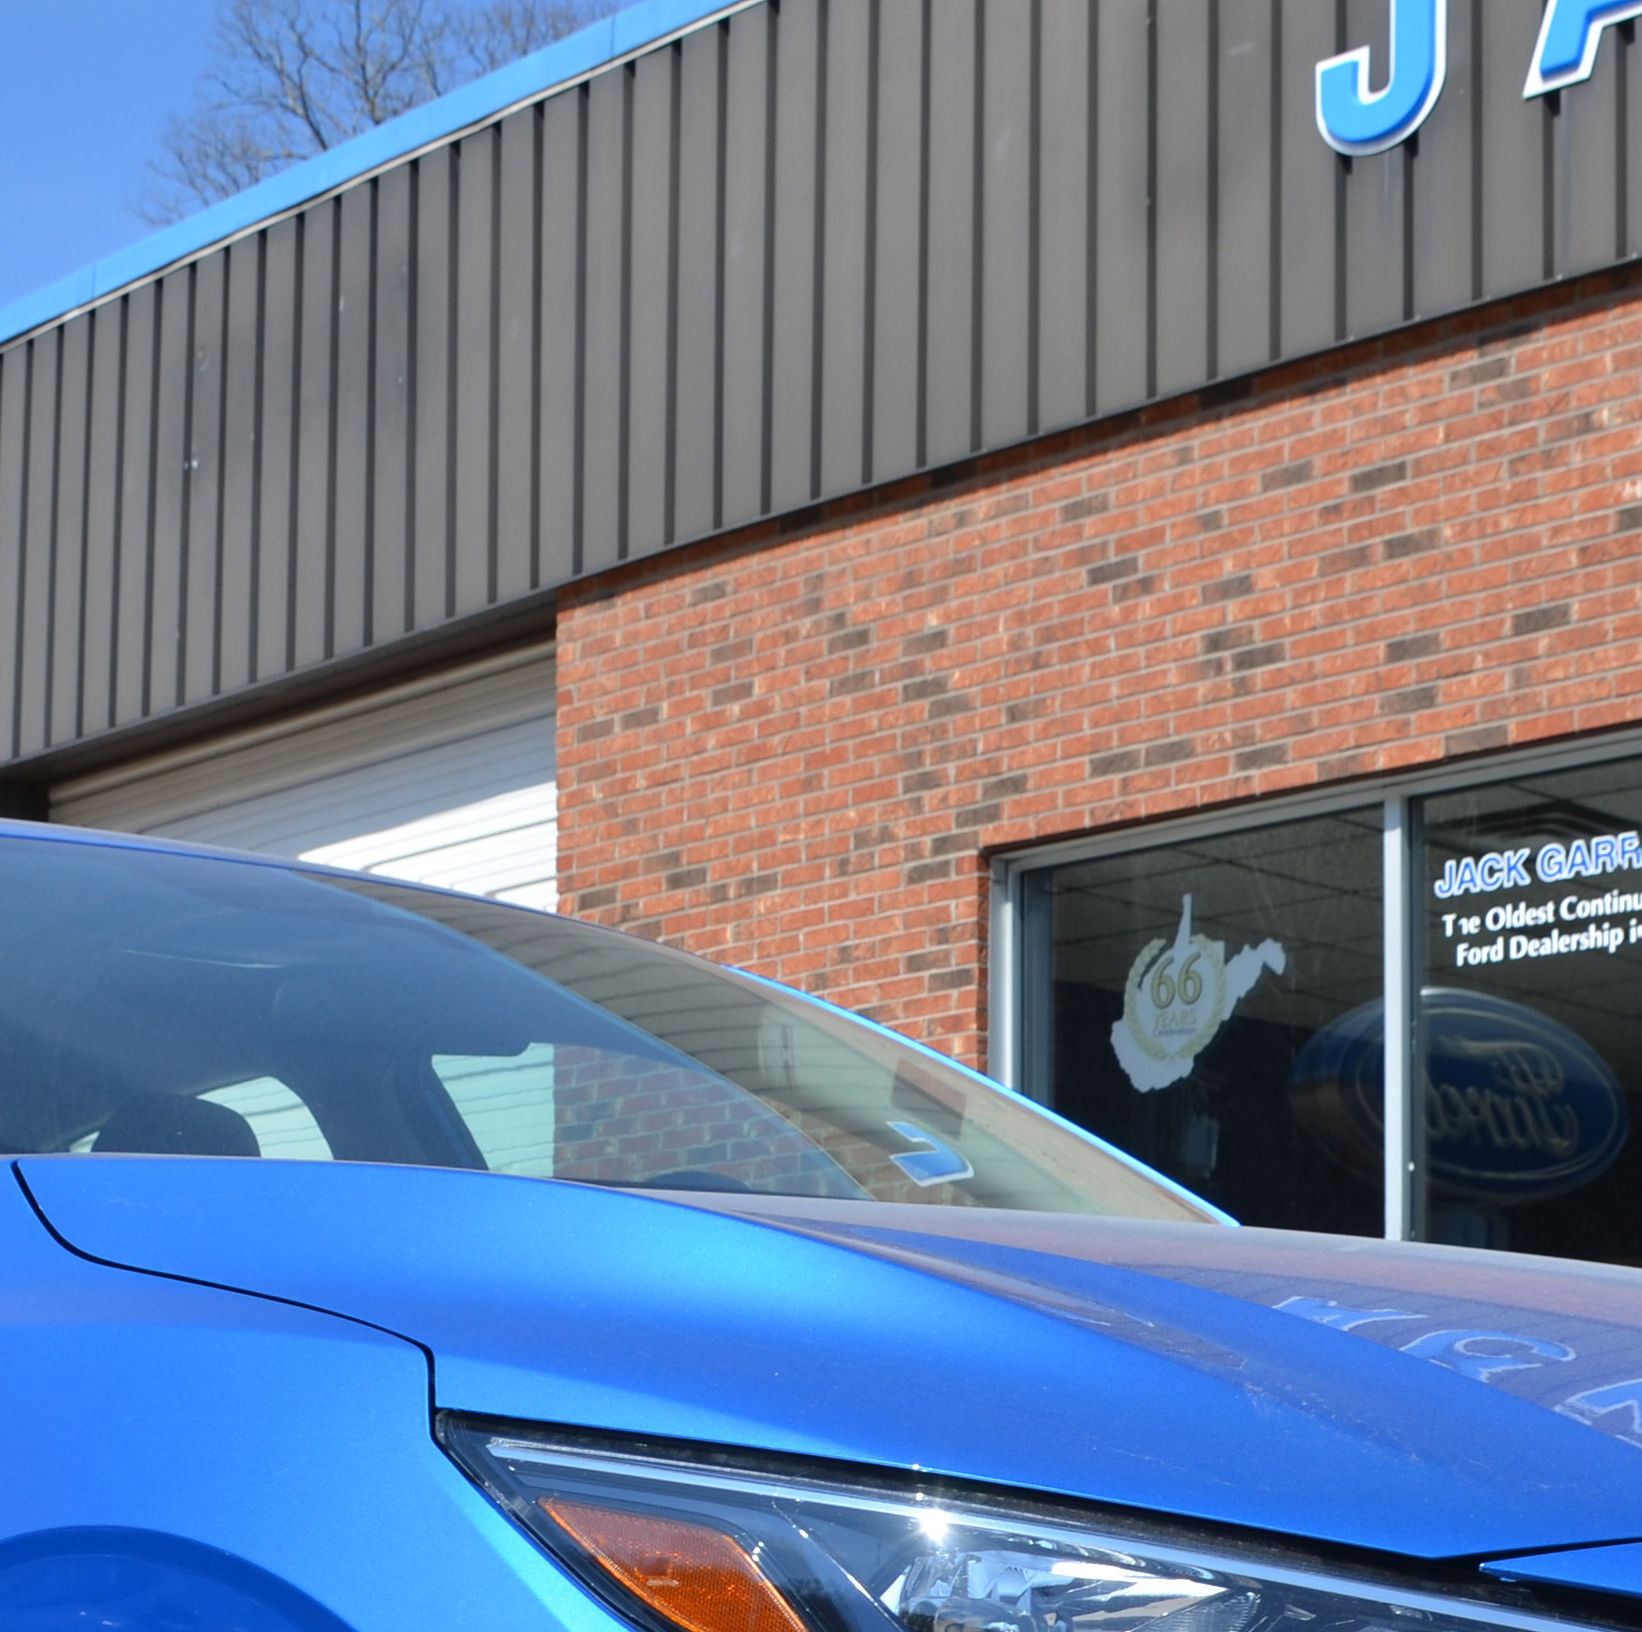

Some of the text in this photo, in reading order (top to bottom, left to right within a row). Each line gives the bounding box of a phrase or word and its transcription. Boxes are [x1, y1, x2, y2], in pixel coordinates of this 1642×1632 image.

[1434, 847, 1531, 898] JACK
[1485, 901, 1555, 931] Oldest
[1456, 936, 1504, 967] Ford
[1509, 922, 1625, 960] Dealership
[1150, 952, 1203, 1009] 66
[1153, 1008, 1198, 1030] YEARS
